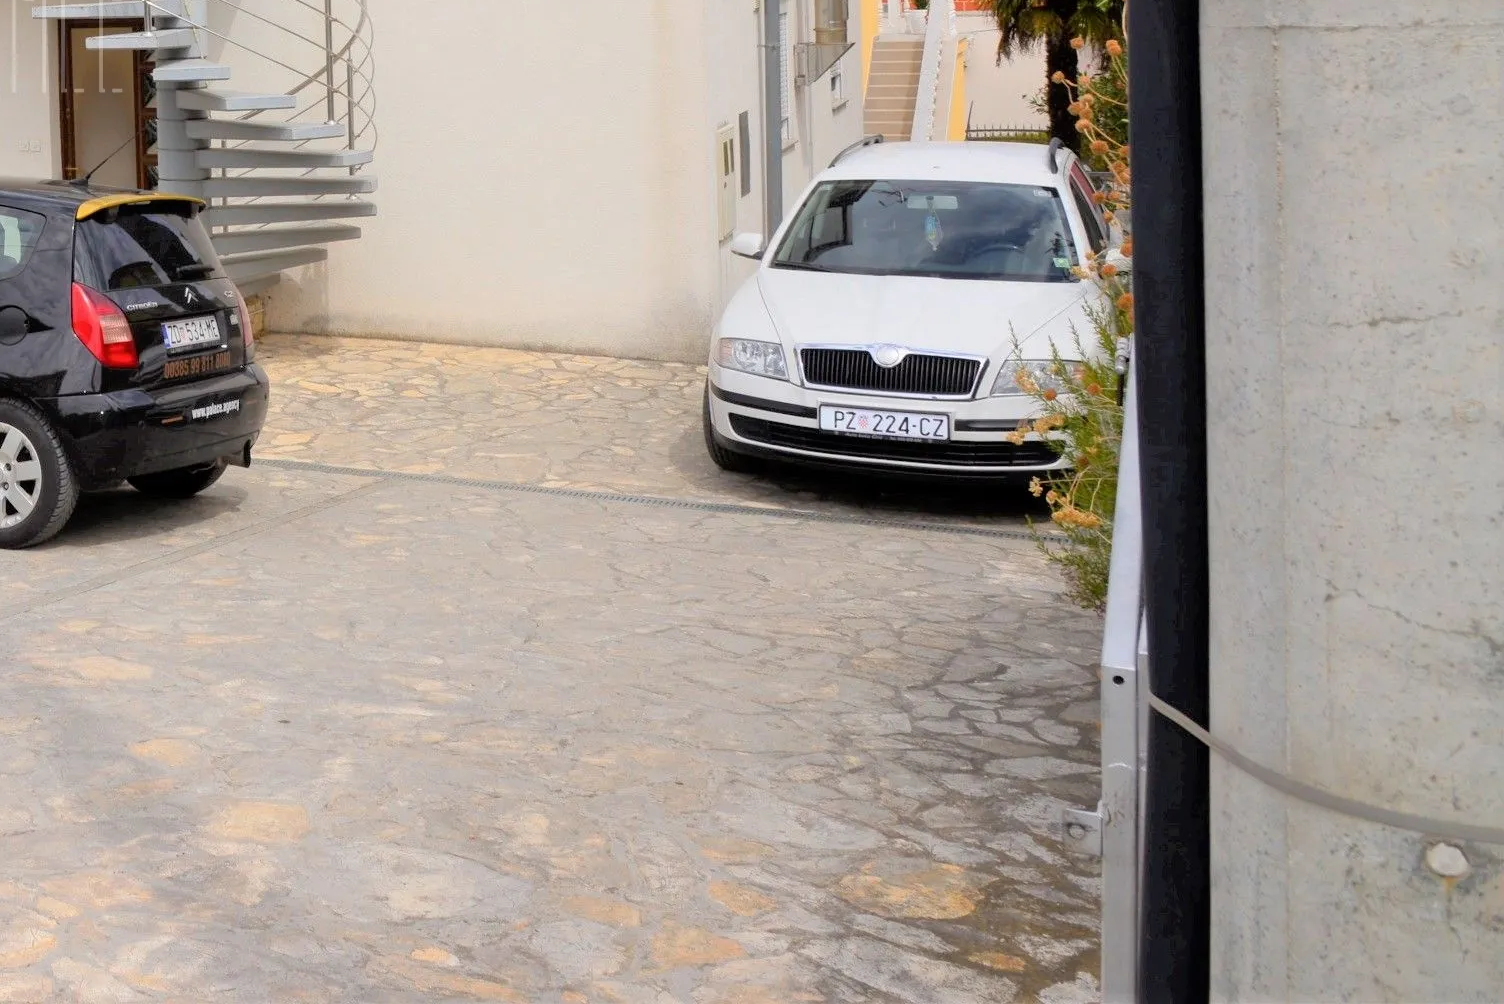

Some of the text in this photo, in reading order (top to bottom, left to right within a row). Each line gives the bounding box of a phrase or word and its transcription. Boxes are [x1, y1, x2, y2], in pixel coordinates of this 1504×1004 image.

[168, 325, 181, 343] ZD
[191, 399, 240, 419] www.palace.agency
[834, 410, 857, 430] PZ
[872, 414, 944, 437] 224-CZ
